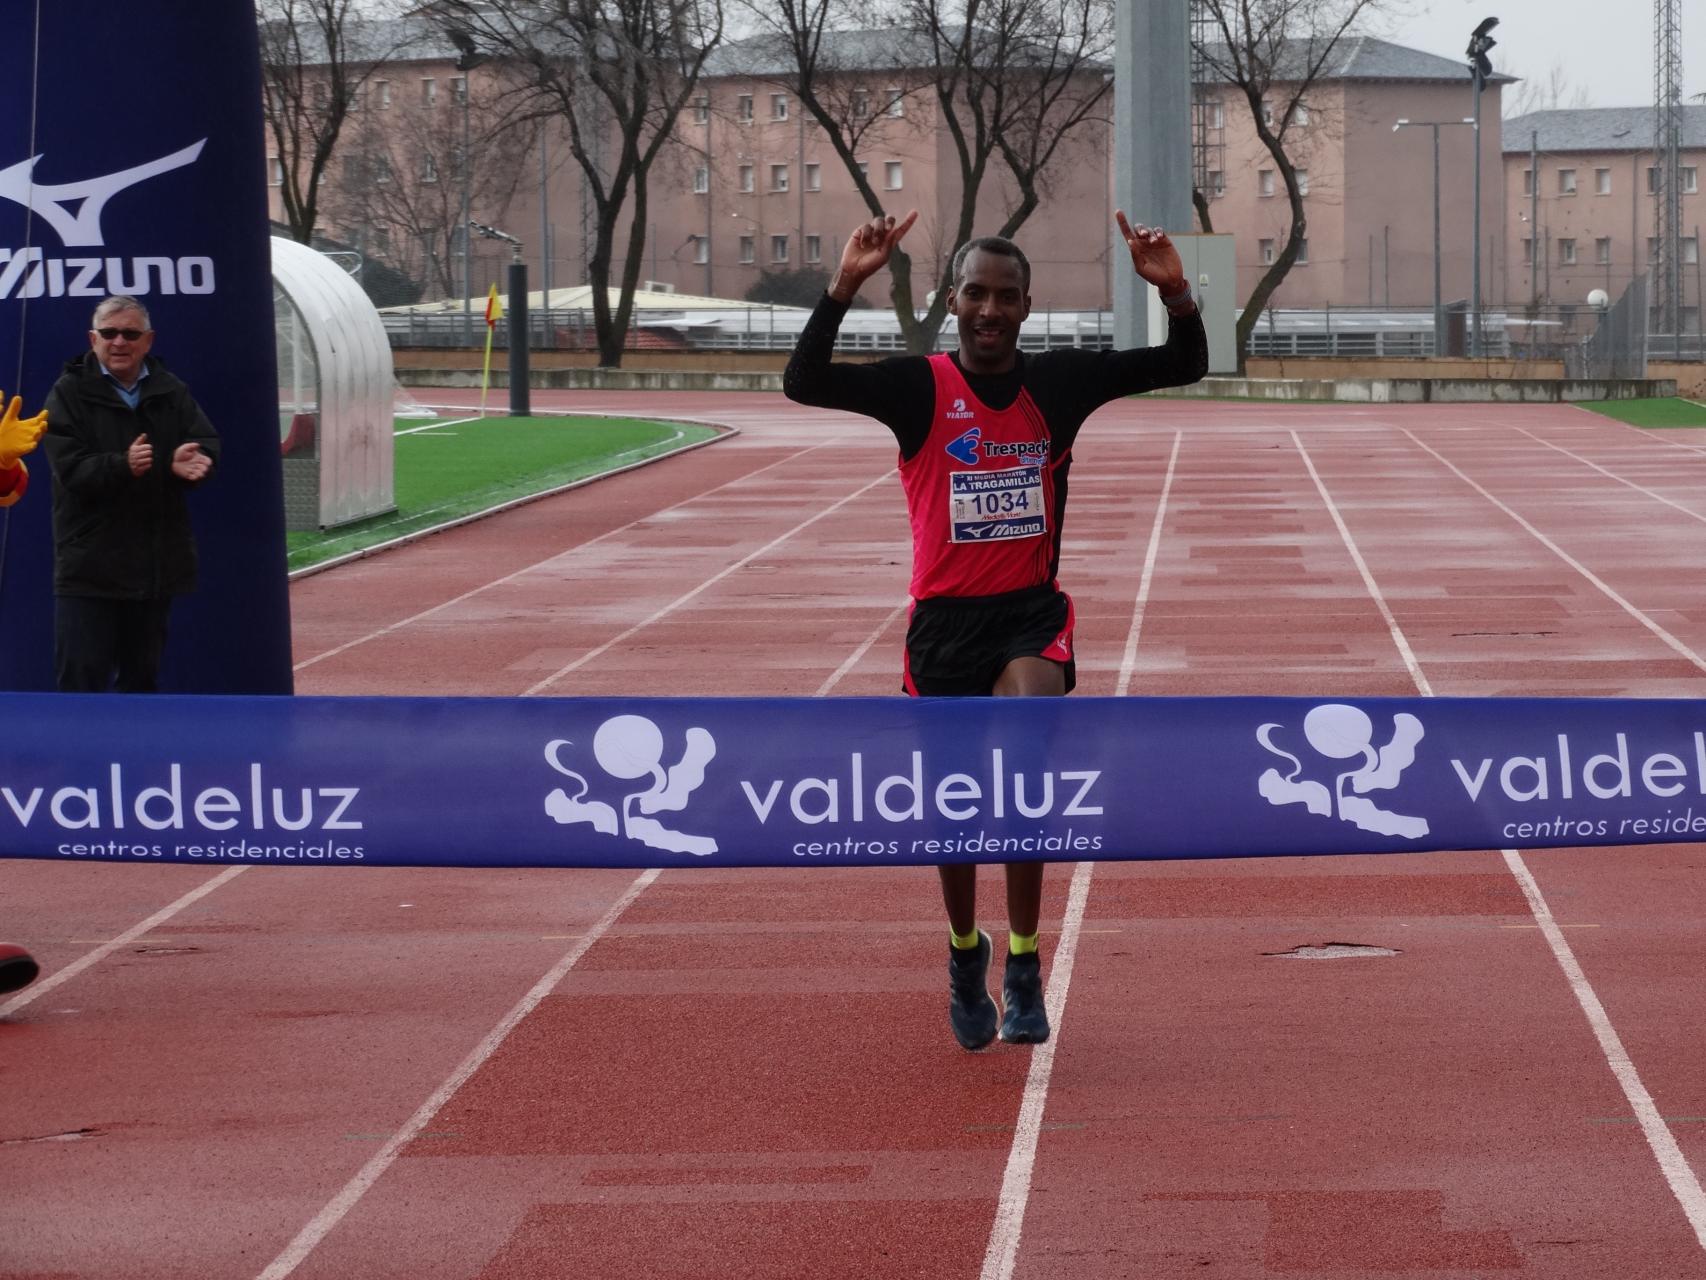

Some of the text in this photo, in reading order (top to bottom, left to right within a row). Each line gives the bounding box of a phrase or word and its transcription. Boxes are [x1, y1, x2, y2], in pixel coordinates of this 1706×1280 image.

[982, 438, 1048, 458] Trespack
[953, 475, 1040, 491] LA TRAGAMILLAS
[974, 473, 996, 481] MEDIA
[972, 490, 1029, 515] 1034
[0, 763, 363, 831] valdeluz
[740, 748, 1104, 825] valdeluz
[1503, 807, 1706, 839] centros reside
[58, 839, 365, 859] centros residenciales
[793, 828, 1103, 856] centros residenciales
